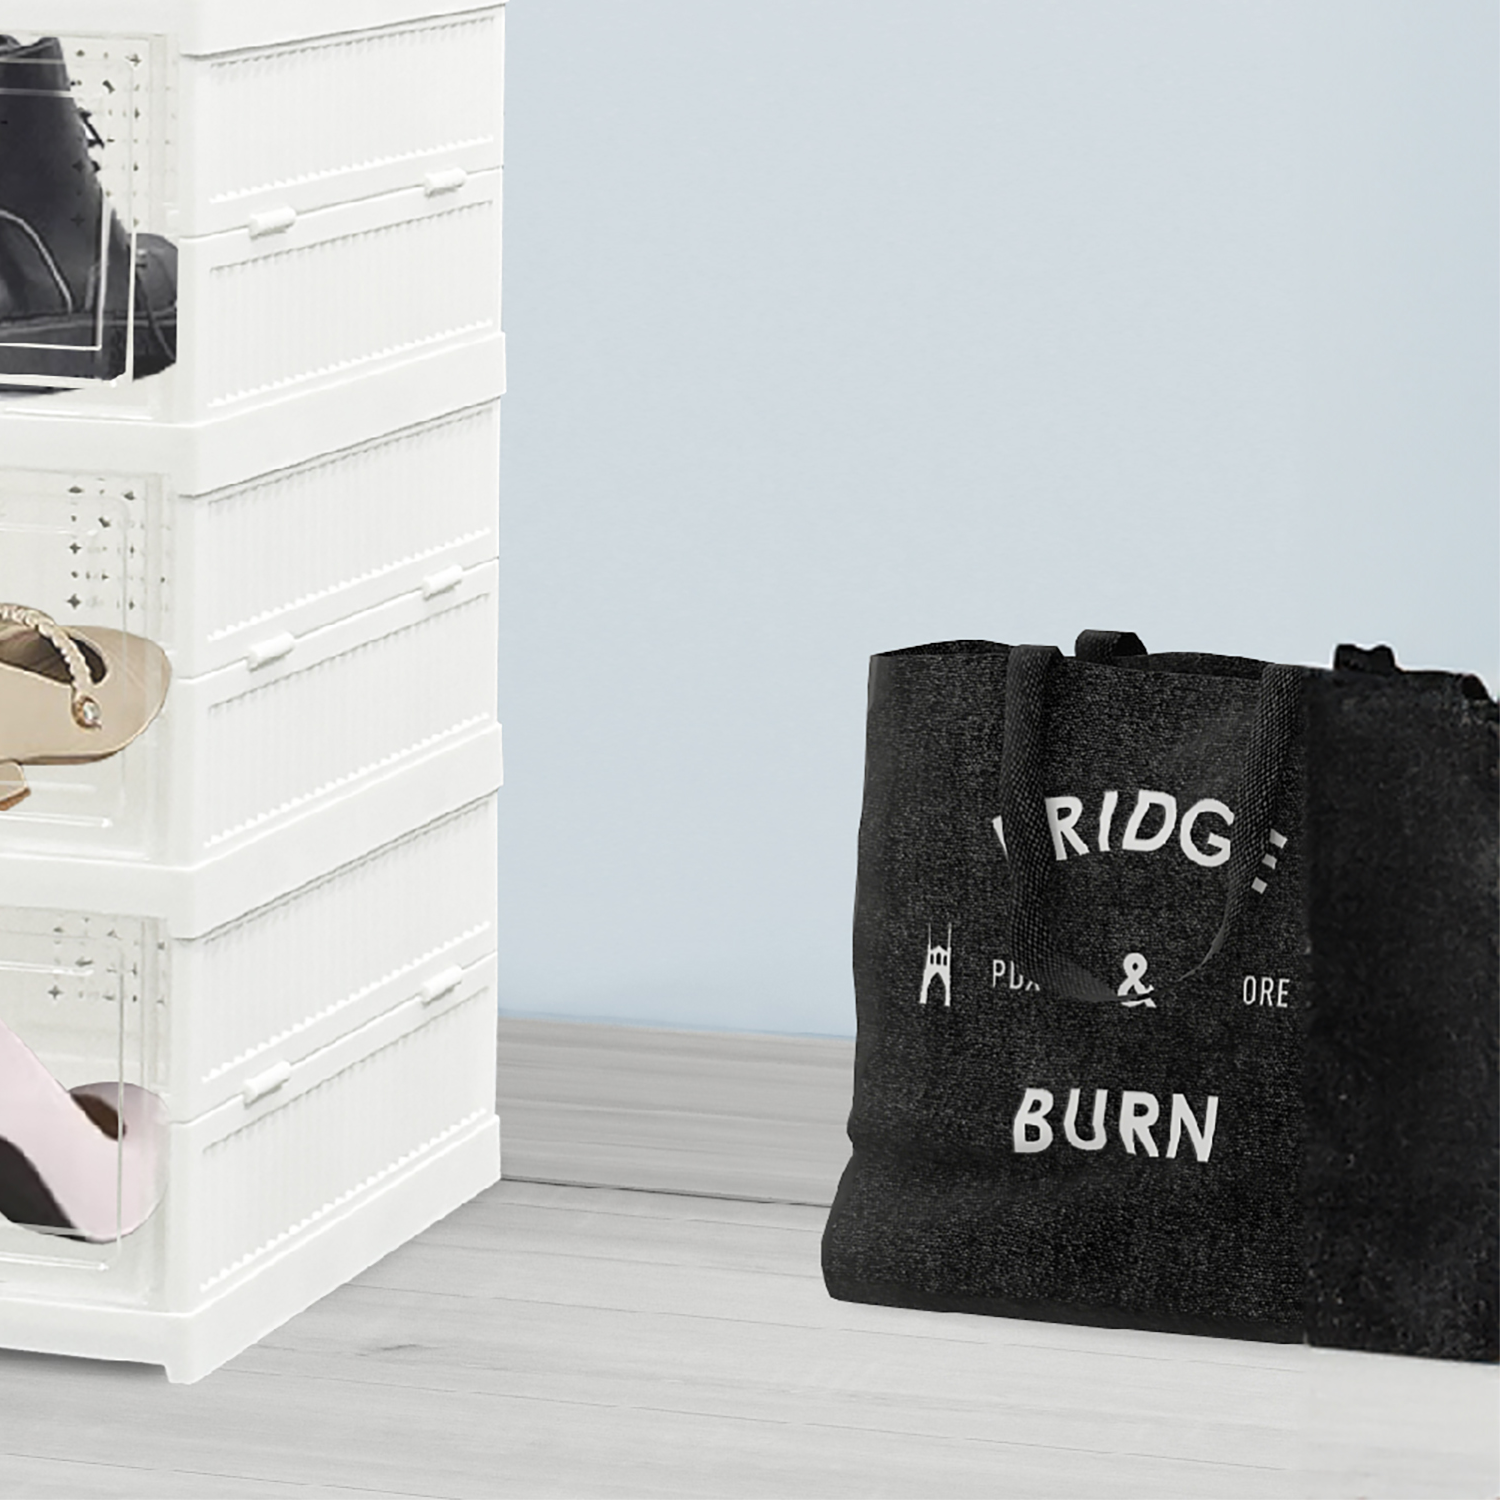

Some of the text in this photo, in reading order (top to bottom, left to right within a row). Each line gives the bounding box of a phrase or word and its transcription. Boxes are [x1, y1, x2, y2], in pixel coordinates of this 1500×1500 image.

[992, 789, 1287, 894] RIDG
[1117, 952, 1157, 1008] &
[1243, 975, 1290, 1007] ORE
[1013, 1087, 1218, 1162] BURN
